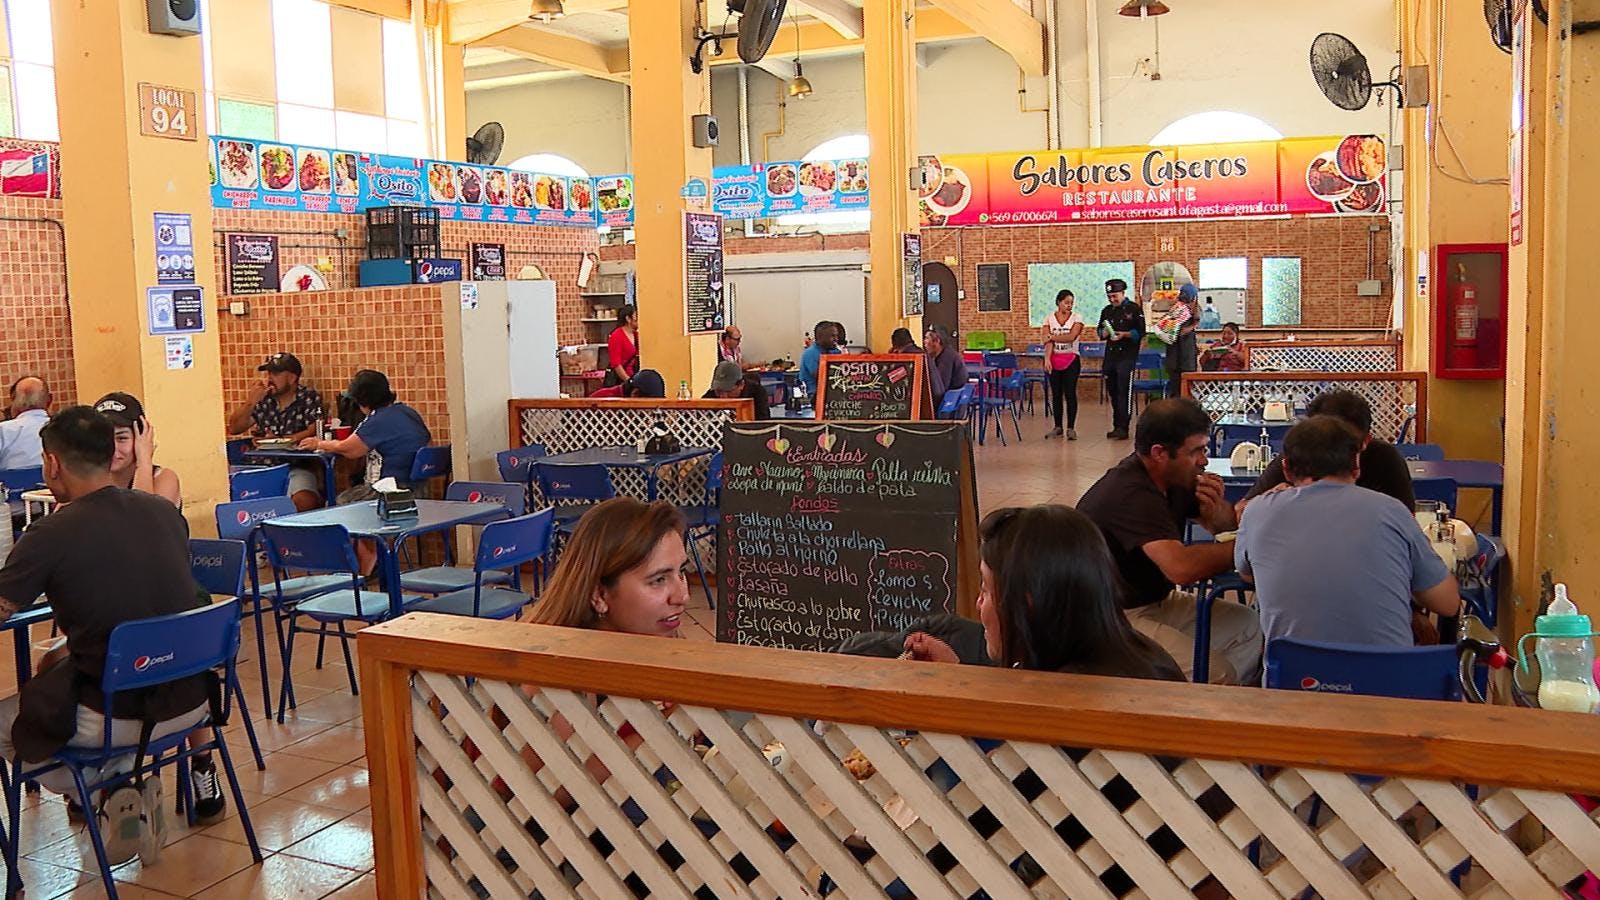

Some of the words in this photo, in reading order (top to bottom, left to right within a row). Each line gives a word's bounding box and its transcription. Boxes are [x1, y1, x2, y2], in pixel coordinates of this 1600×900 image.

[152, 106, 188, 134] 94
[1013, 156, 1131, 195] Sabores
[1142, 150, 1248, 187] Caseros
[379, 176, 414, 192] Osito
[1062, 187, 1197, 207] RESTAURANTE
[433, 266, 456, 279] pepsi
[856, 481, 875, 493] de
[799, 531, 811, 545] la
[193, 555, 223, 567] pepsi
[737, 541, 772, 558] Pollo
[775, 543, 790, 558] al
[794, 545, 838, 565] horno
[736, 557, 799, 577] Estofado
[803, 561, 821, 577] de
[823, 565, 859, 586] pollo
[876, 569, 916, 590] Lomo
[737, 573, 789, 596] Lasaña
[875, 587, 932, 612] Ceviche
[736, 593, 796, 612] Churrasco
[797, 603, 808, 615] a
[810, 597, 823, 616] lo
[825, 598, 861, 629] pobre
[736, 610, 802, 637] Estofado
[804, 619, 822, 638] de
[150, 652, 174, 665] pepsi
